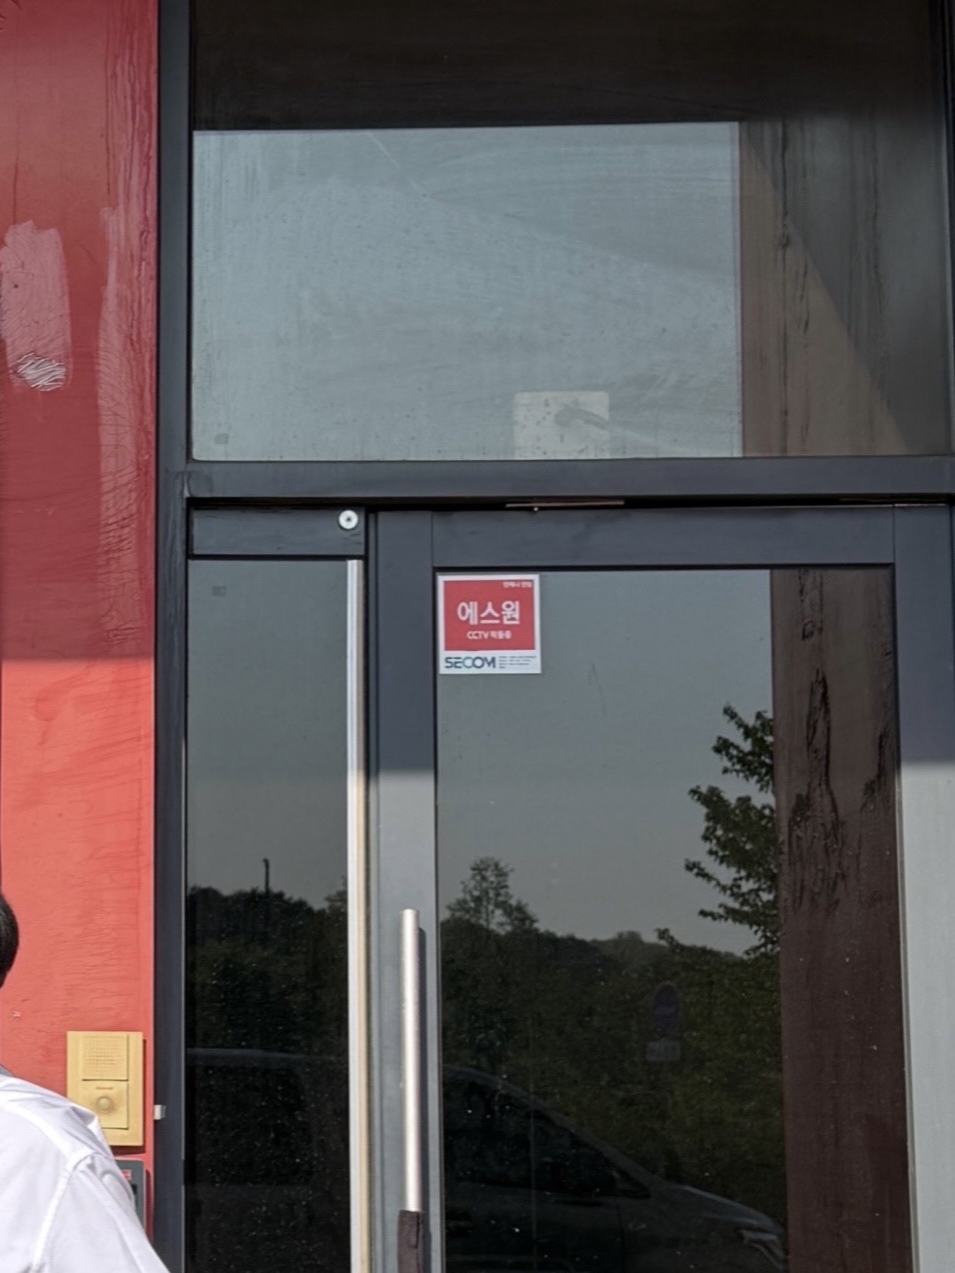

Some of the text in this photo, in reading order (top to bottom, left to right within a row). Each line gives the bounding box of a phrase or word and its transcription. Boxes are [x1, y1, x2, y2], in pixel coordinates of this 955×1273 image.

[457, 600, 520, 625] 에스원
[467, 630, 489, 639] CCTV
[444, 656, 497, 670] SECOM
